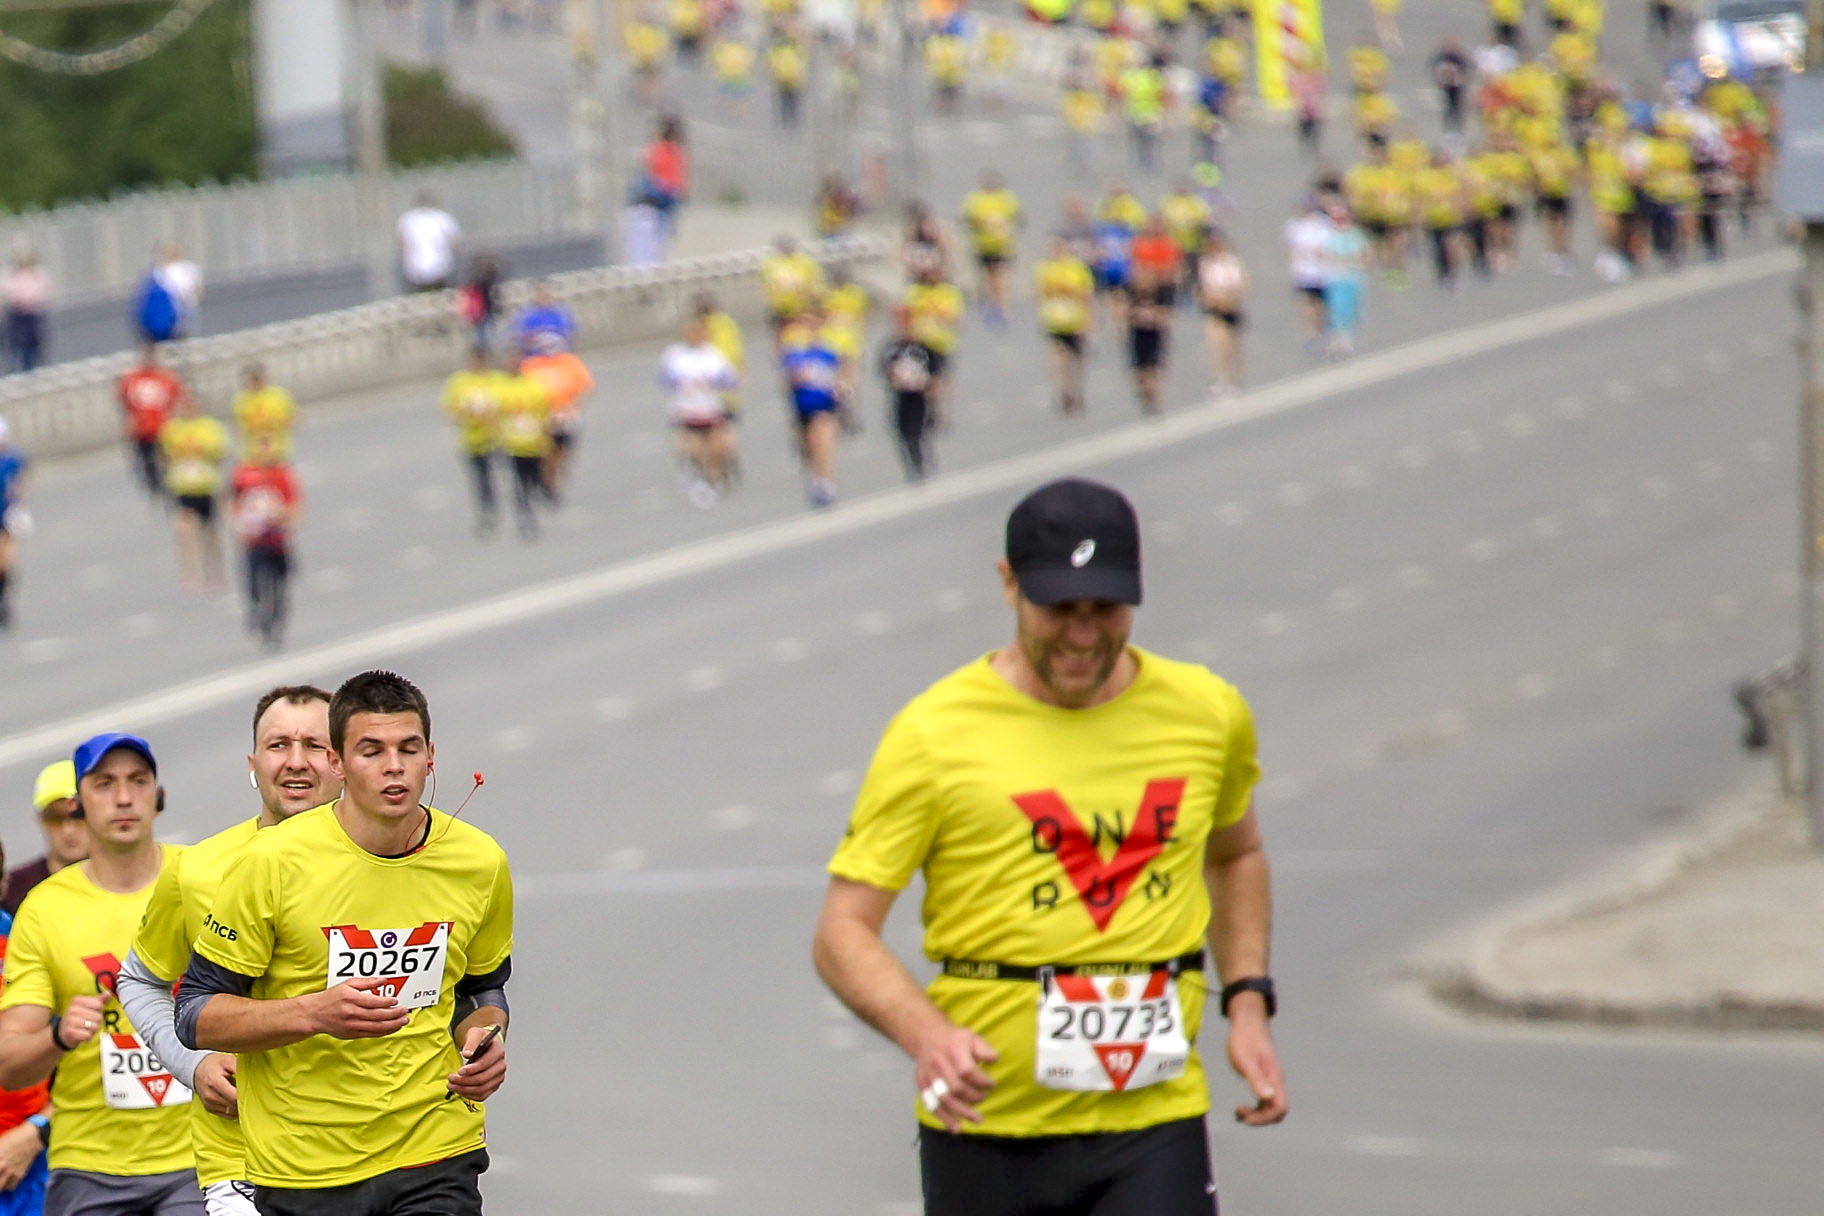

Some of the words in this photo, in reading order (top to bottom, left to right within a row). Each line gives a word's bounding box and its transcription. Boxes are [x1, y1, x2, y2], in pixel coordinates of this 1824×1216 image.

[1032, 804, 1179, 854] ONE
[1032, 872, 1172, 912] RUN
[336, 946, 440, 977] 20267
[1051, 1000, 1174, 1040] 20733
[147, 1079, 167, 1093] 10
